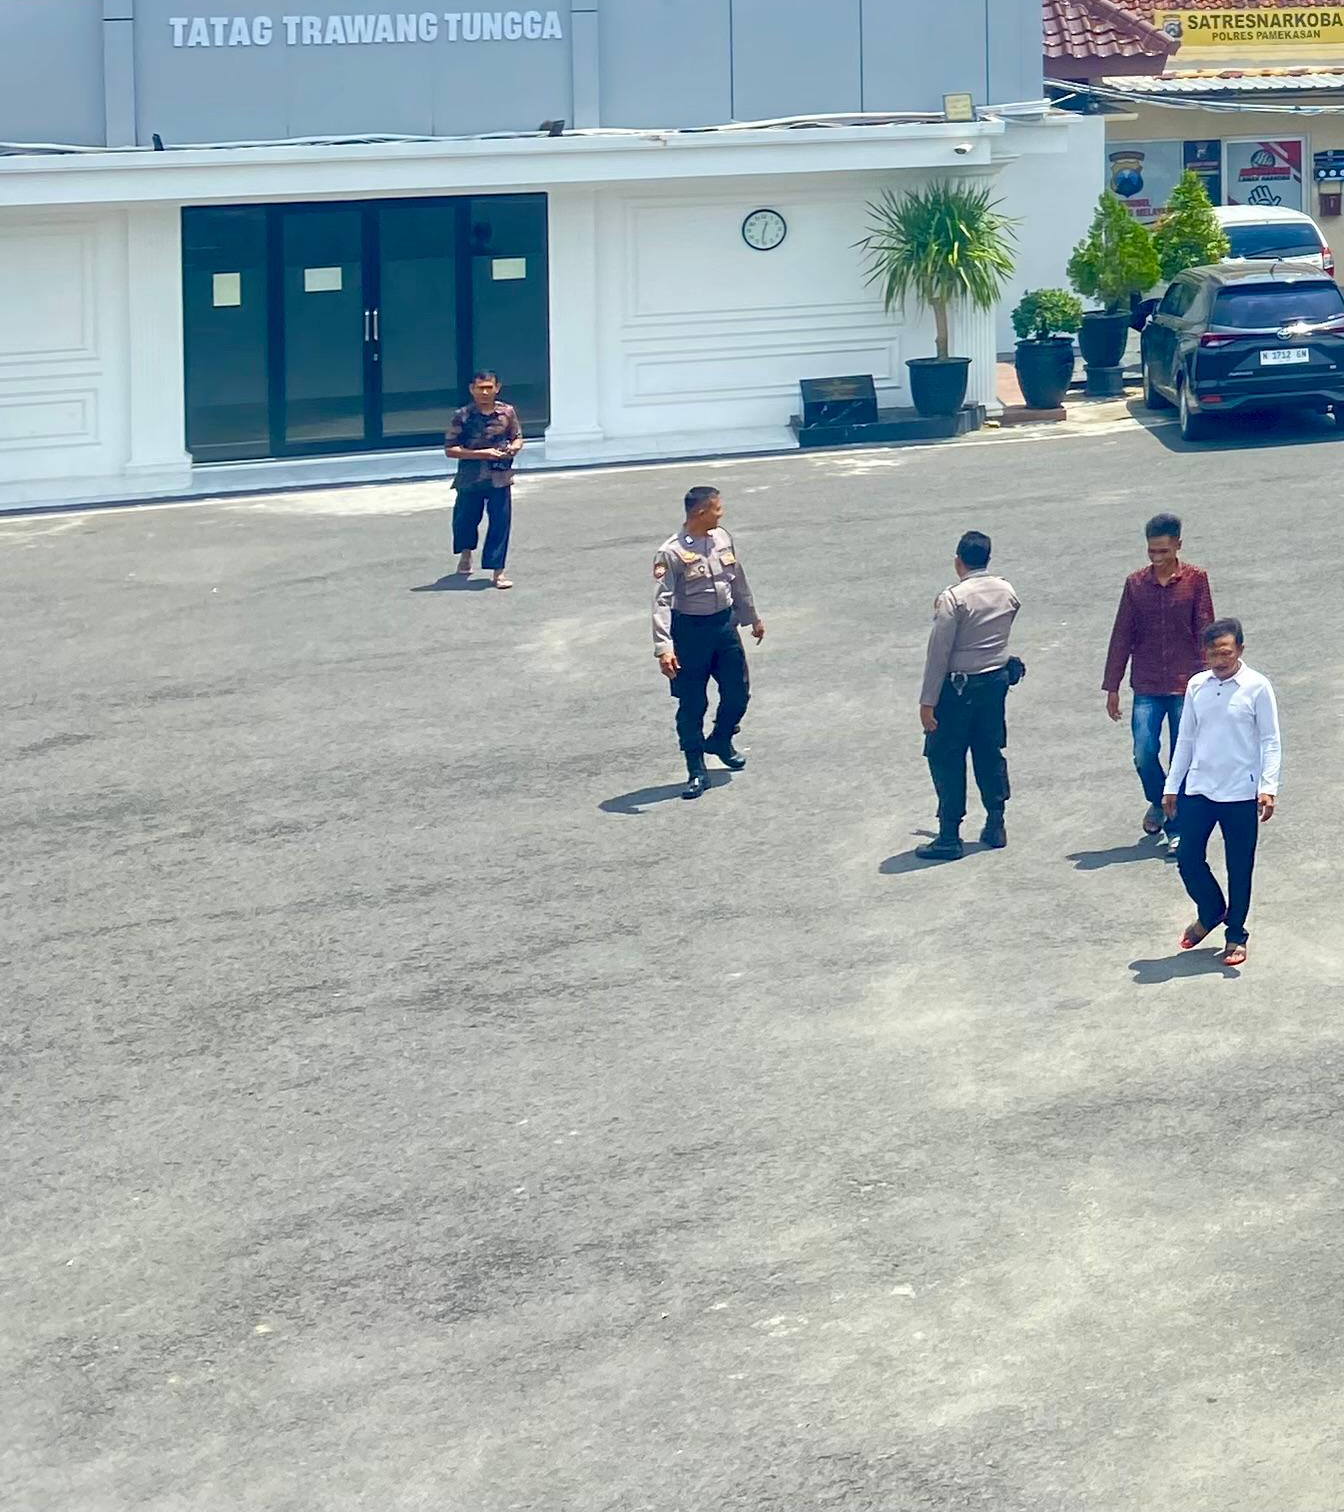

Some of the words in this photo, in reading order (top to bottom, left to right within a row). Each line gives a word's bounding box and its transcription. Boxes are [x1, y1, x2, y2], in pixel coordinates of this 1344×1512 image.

[168, 15, 273, 48] TATAG
[281, 12, 438, 46] TRAWANG
[444, 10, 563, 42] TUNGGA
[1187, 12, 1344, 30] SATRESNARKOBA
[1212, 31, 1254, 41] POLRES
[1256, 30, 1321, 40] PAMEKASAN
